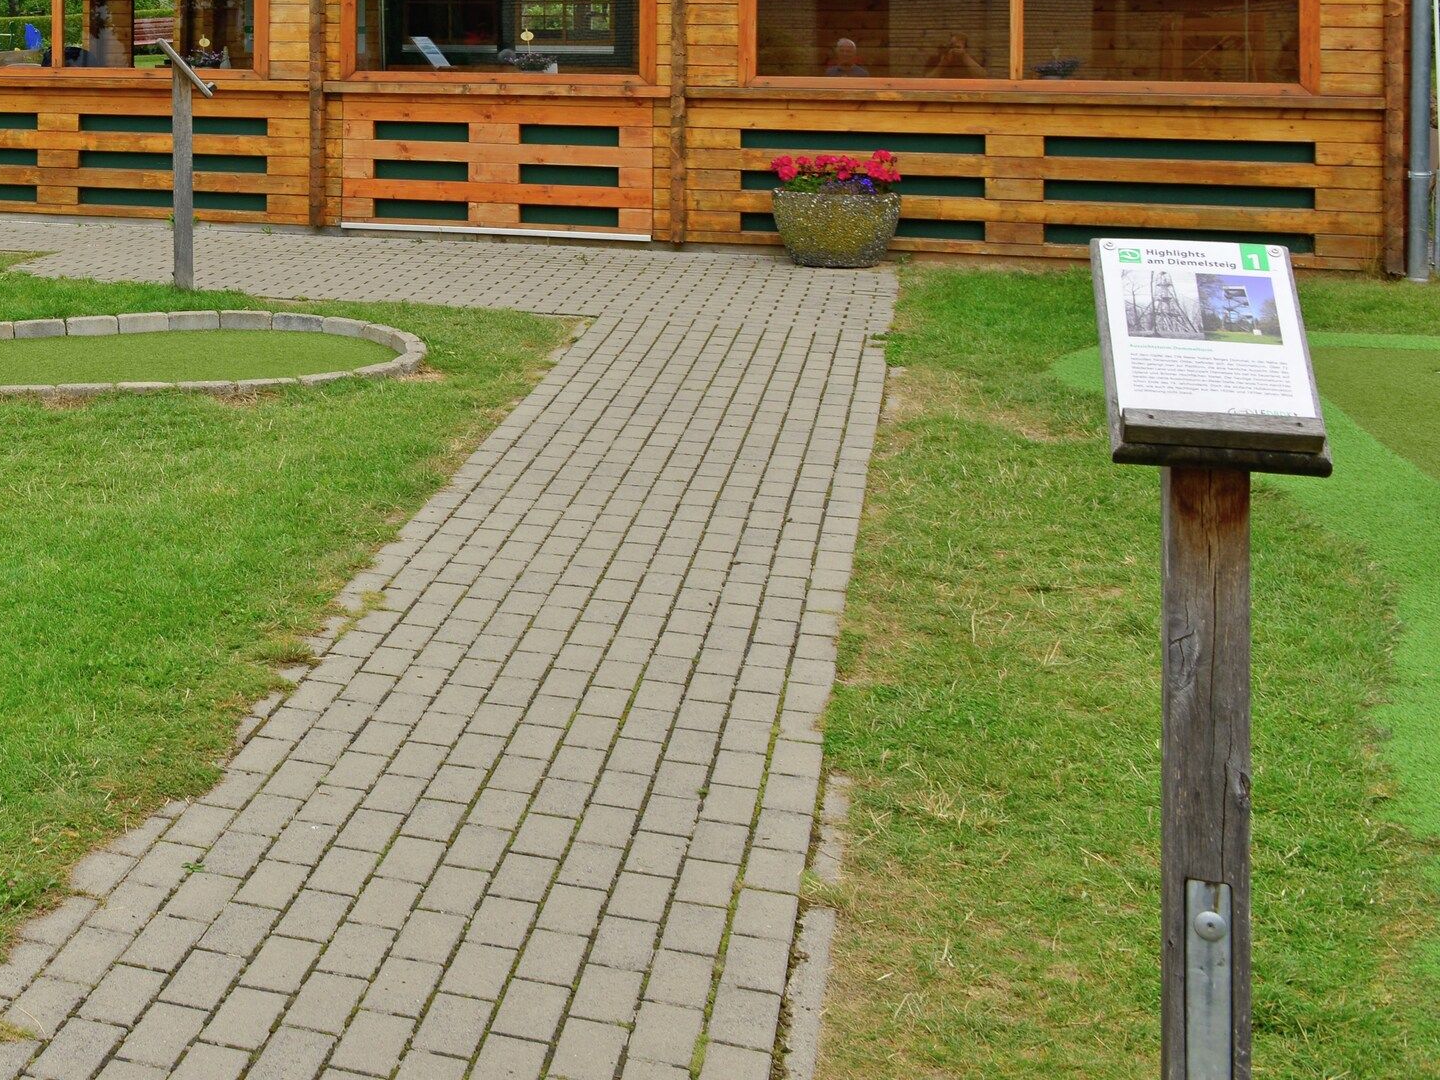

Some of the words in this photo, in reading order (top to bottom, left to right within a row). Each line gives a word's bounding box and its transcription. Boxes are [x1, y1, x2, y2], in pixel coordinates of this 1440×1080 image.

[1145, 248, 1206, 258] Highlights
[1167, 258, 1237, 270] Diemelsteig
[1247, 253, 1260, 270] 1
